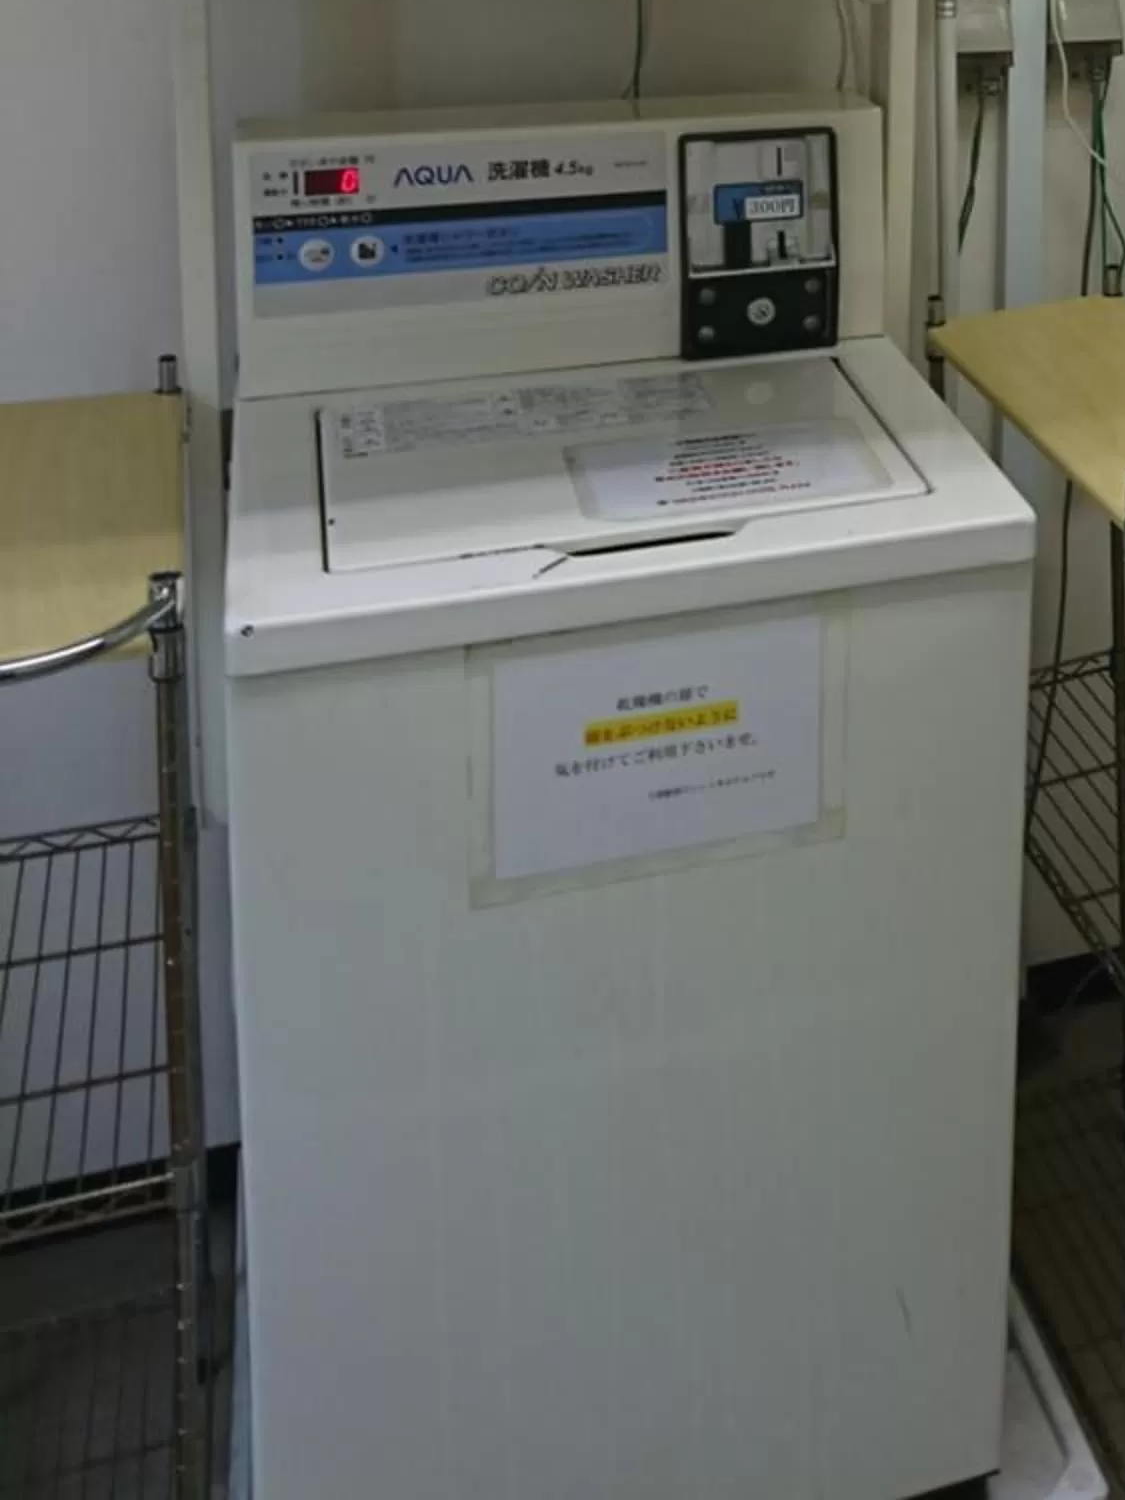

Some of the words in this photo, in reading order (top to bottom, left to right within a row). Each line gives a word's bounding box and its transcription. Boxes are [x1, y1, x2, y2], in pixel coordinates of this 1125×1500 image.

[341, 168, 358, 193] 0
[393, 164, 474, 188] AQUA
[487, 157, 551, 182] 洗濯機
